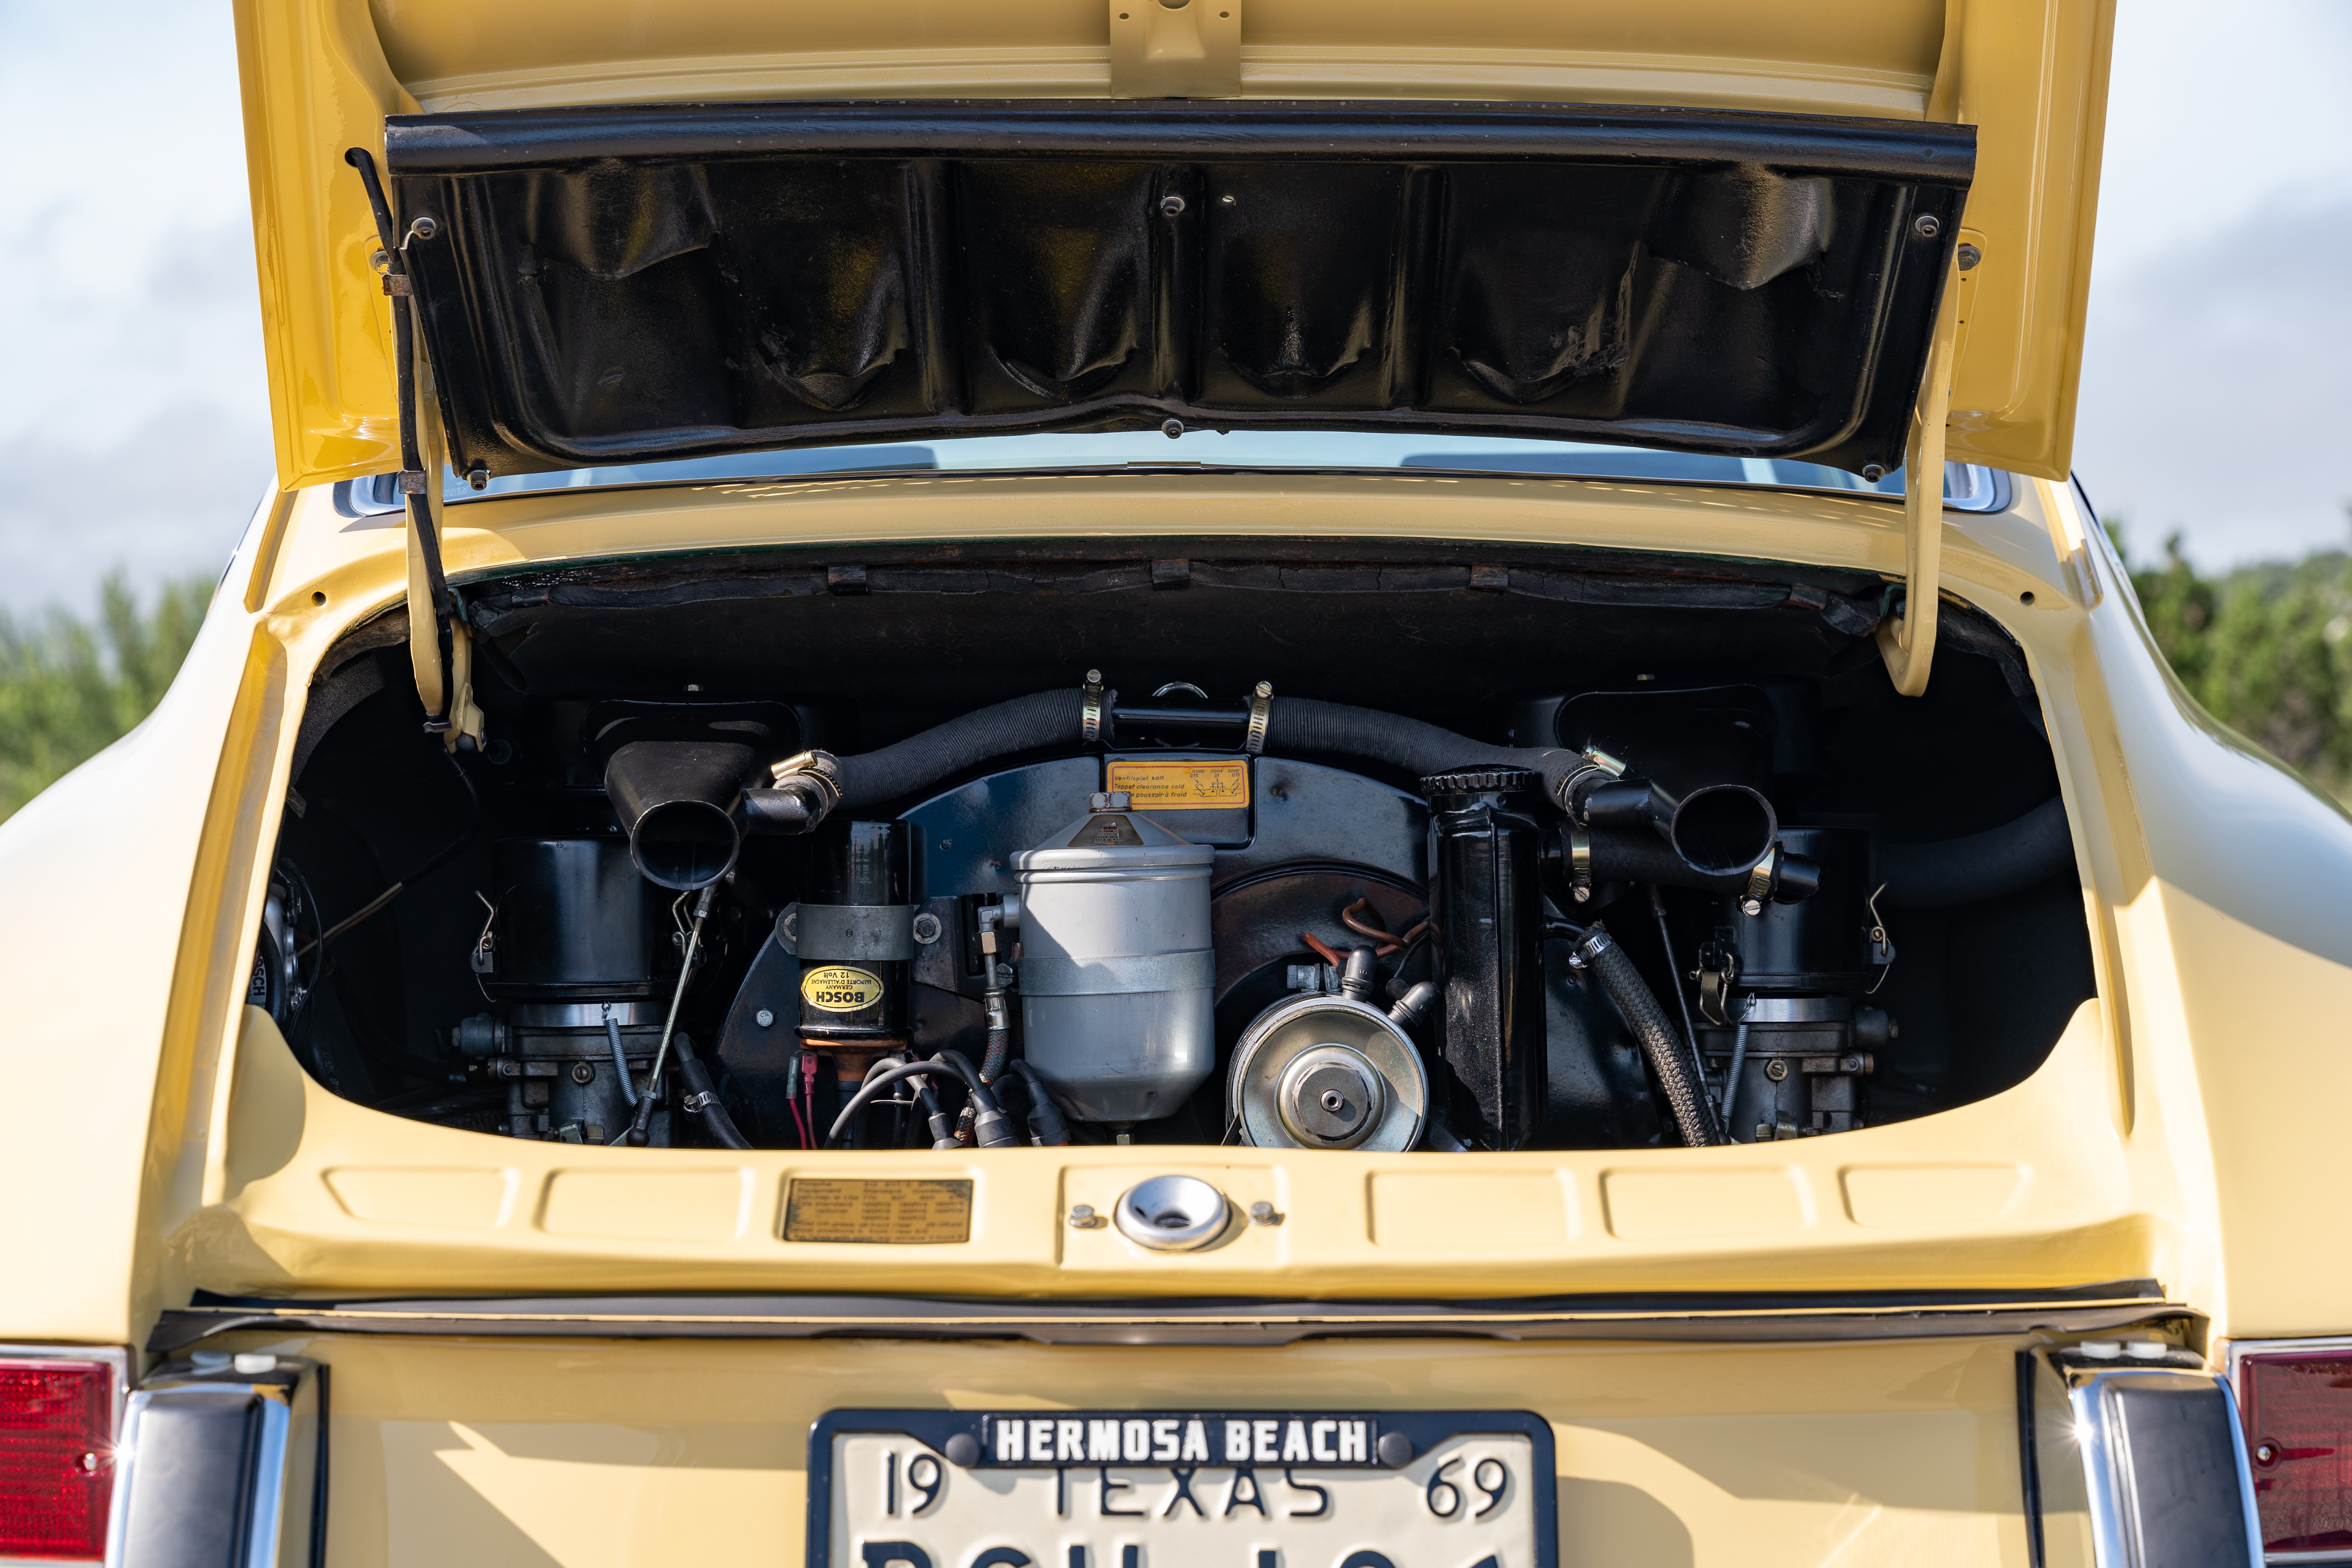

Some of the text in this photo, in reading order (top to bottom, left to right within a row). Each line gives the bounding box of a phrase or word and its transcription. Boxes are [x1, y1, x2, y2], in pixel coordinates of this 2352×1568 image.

[253, 958, 265, 996] OSCH
[816, 991, 865, 1003] BOSCH
[996, 1419, 1367, 1462] HERMOSA BEACH
[887, 1451, 942, 1515] 19
[1426, 1457, 1507, 1518] 69
